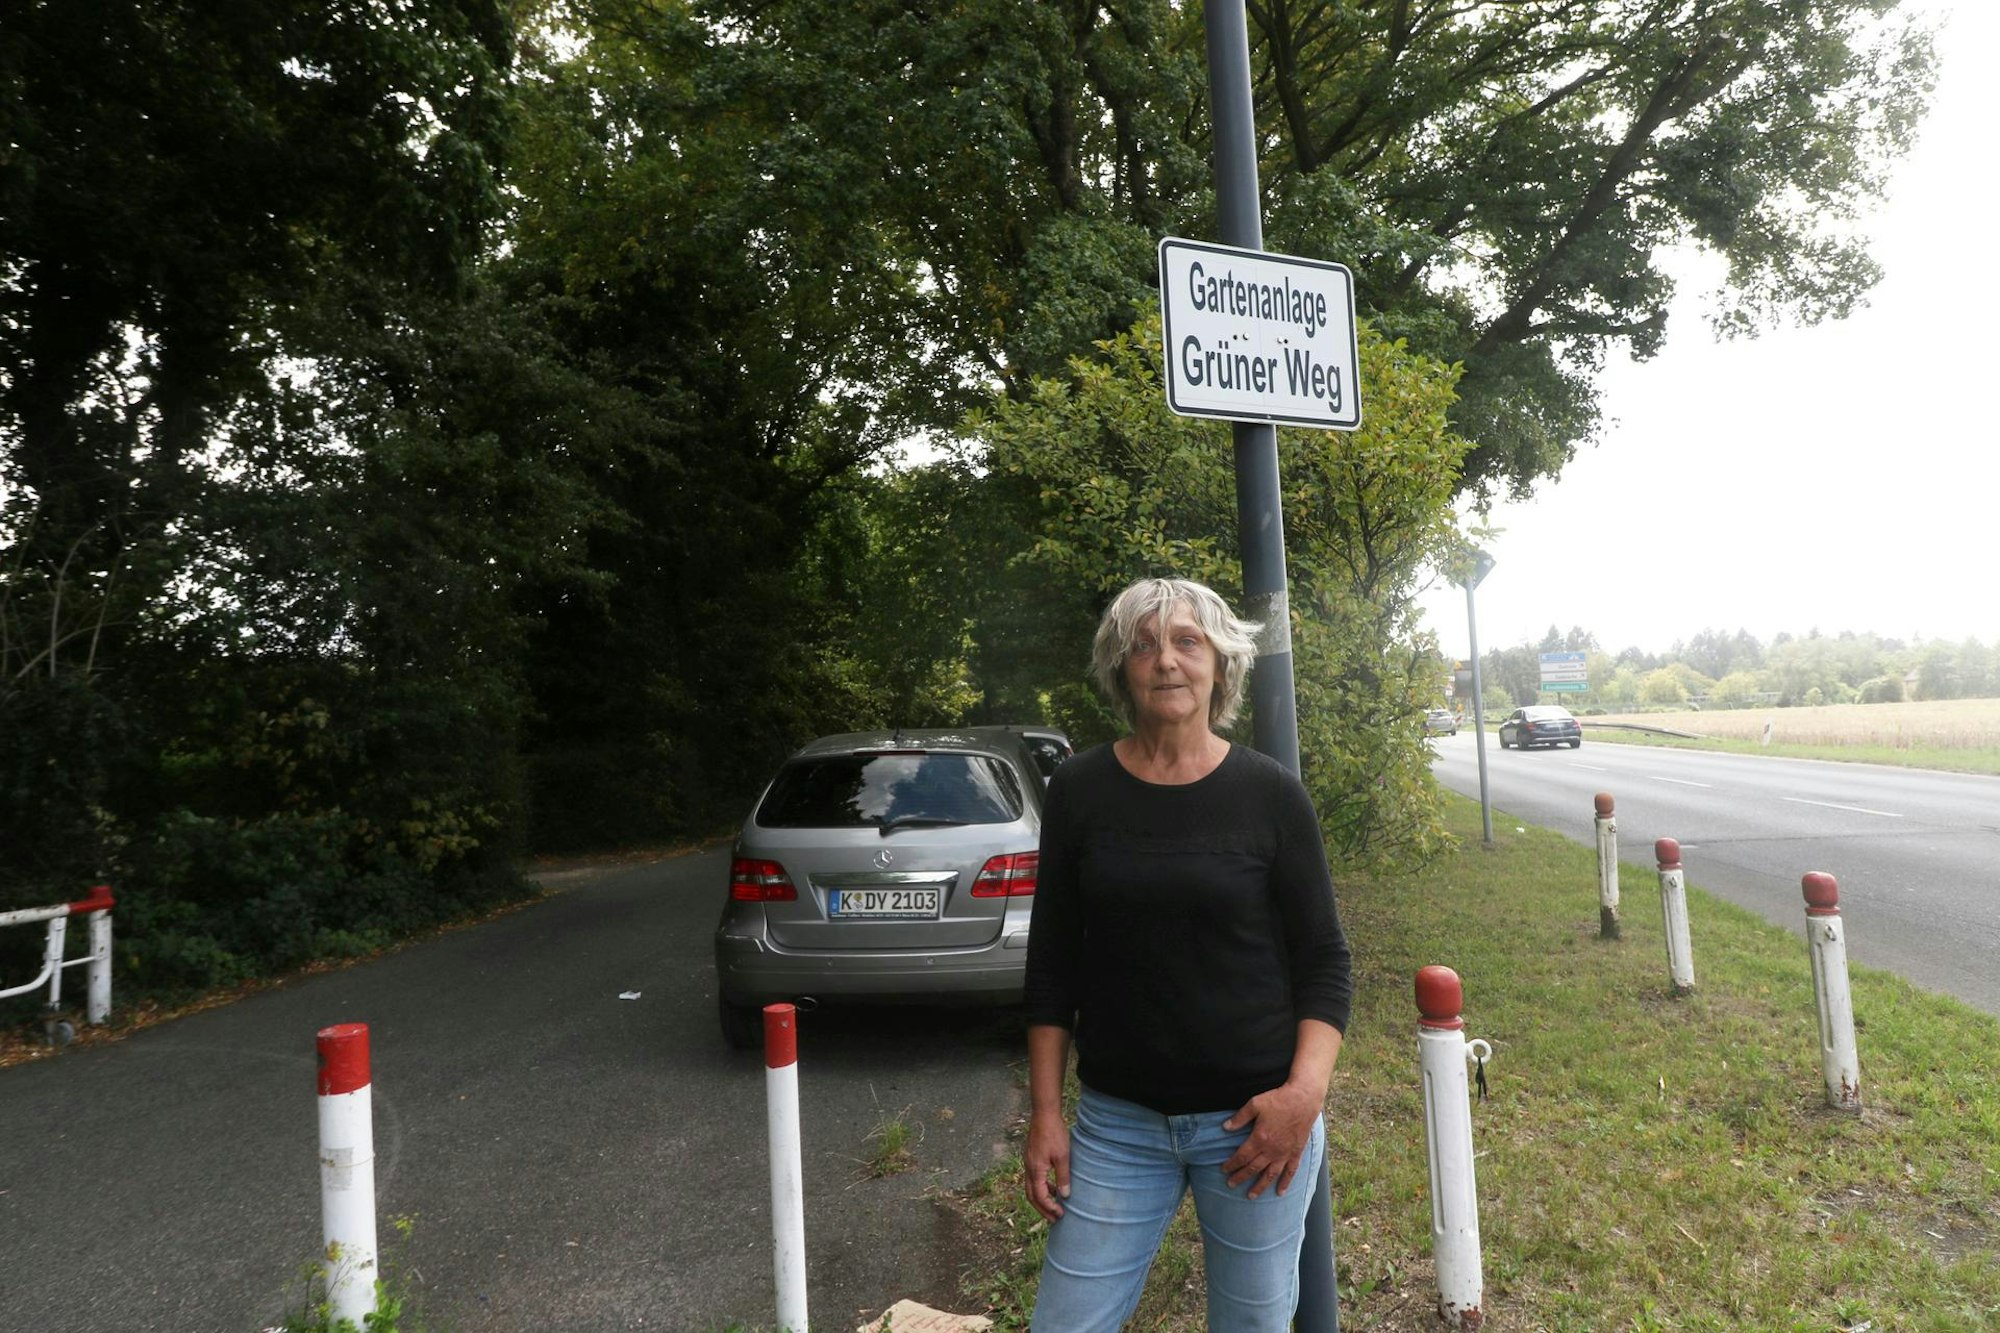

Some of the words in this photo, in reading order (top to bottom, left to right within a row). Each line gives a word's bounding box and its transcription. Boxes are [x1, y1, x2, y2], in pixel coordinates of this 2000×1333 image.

[1189, 261, 1327, 339] Gartenanlage
[1182, 334, 1278, 394] Grüner
[1284, 347, 1343, 414] Weg
[841, 892, 852, 910] K
[865, 892, 888, 910] DY
[891, 892, 937, 910] 2103
